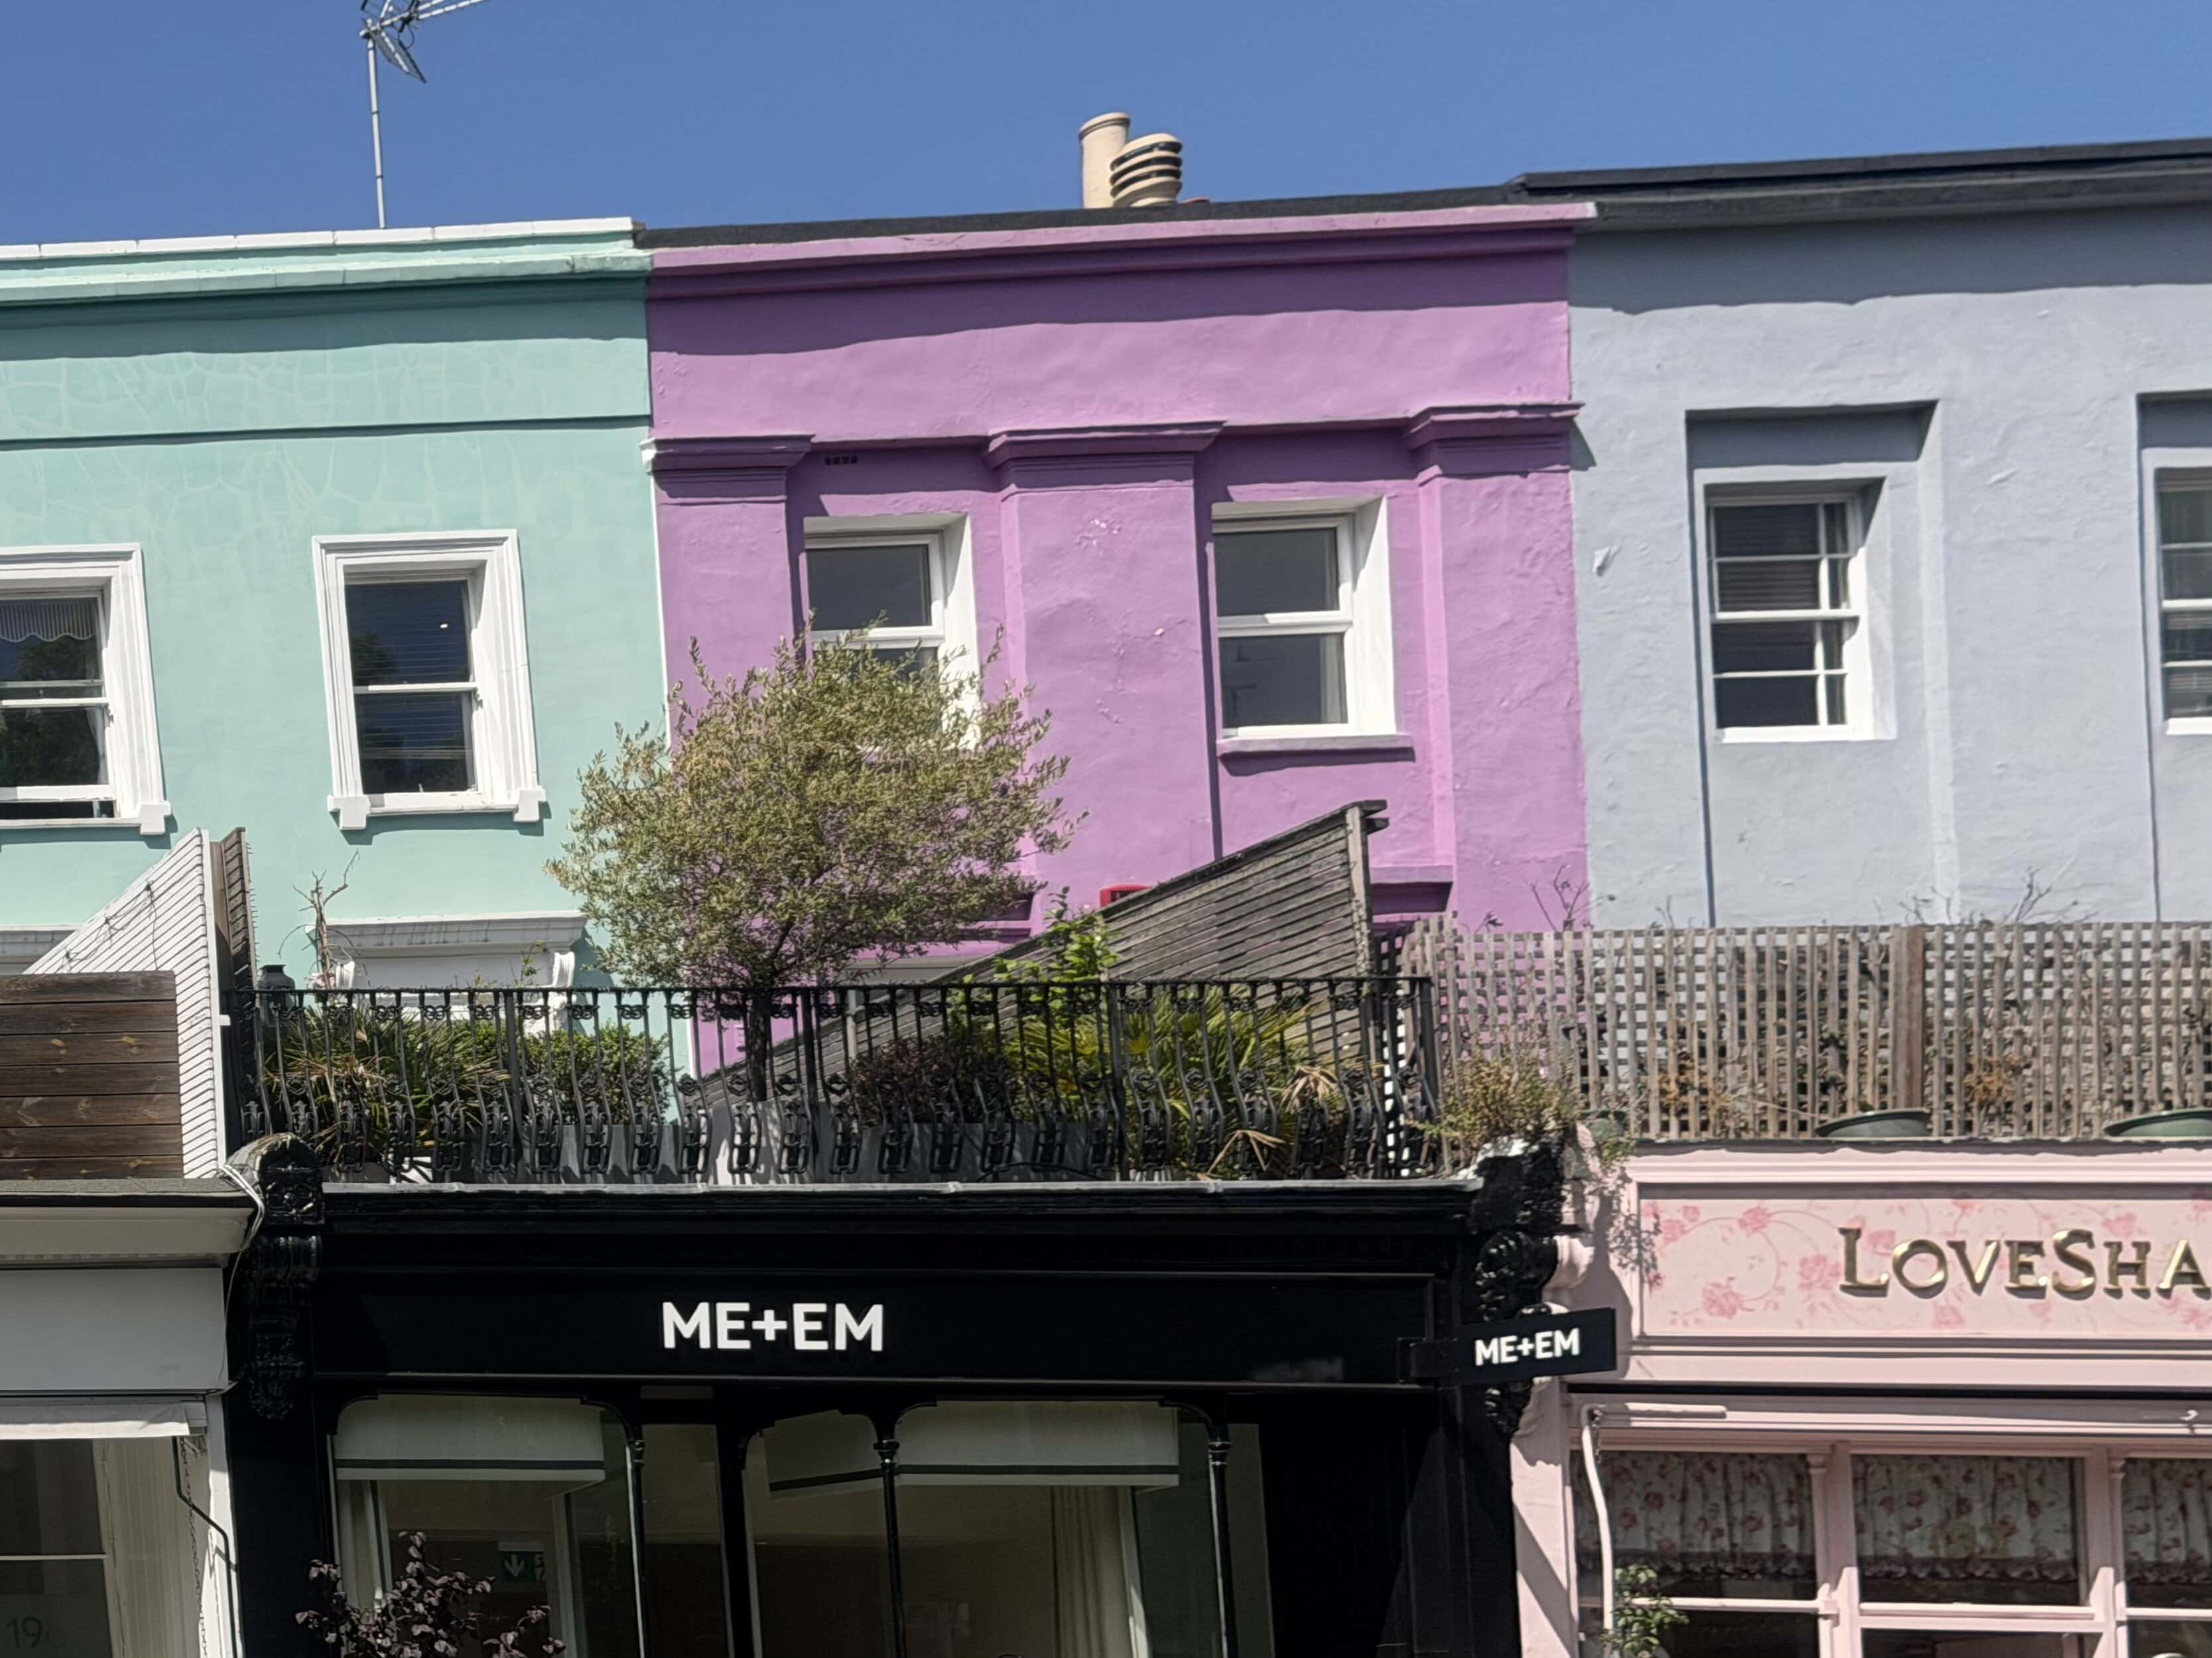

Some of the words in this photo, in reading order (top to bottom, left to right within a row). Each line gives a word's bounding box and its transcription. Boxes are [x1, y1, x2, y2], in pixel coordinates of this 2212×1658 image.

[662, 1302, 883, 1352] ME+EM
[1474, 1327, 1581, 1366] ME+EM
[6, 1616, 42, 1649] 19
